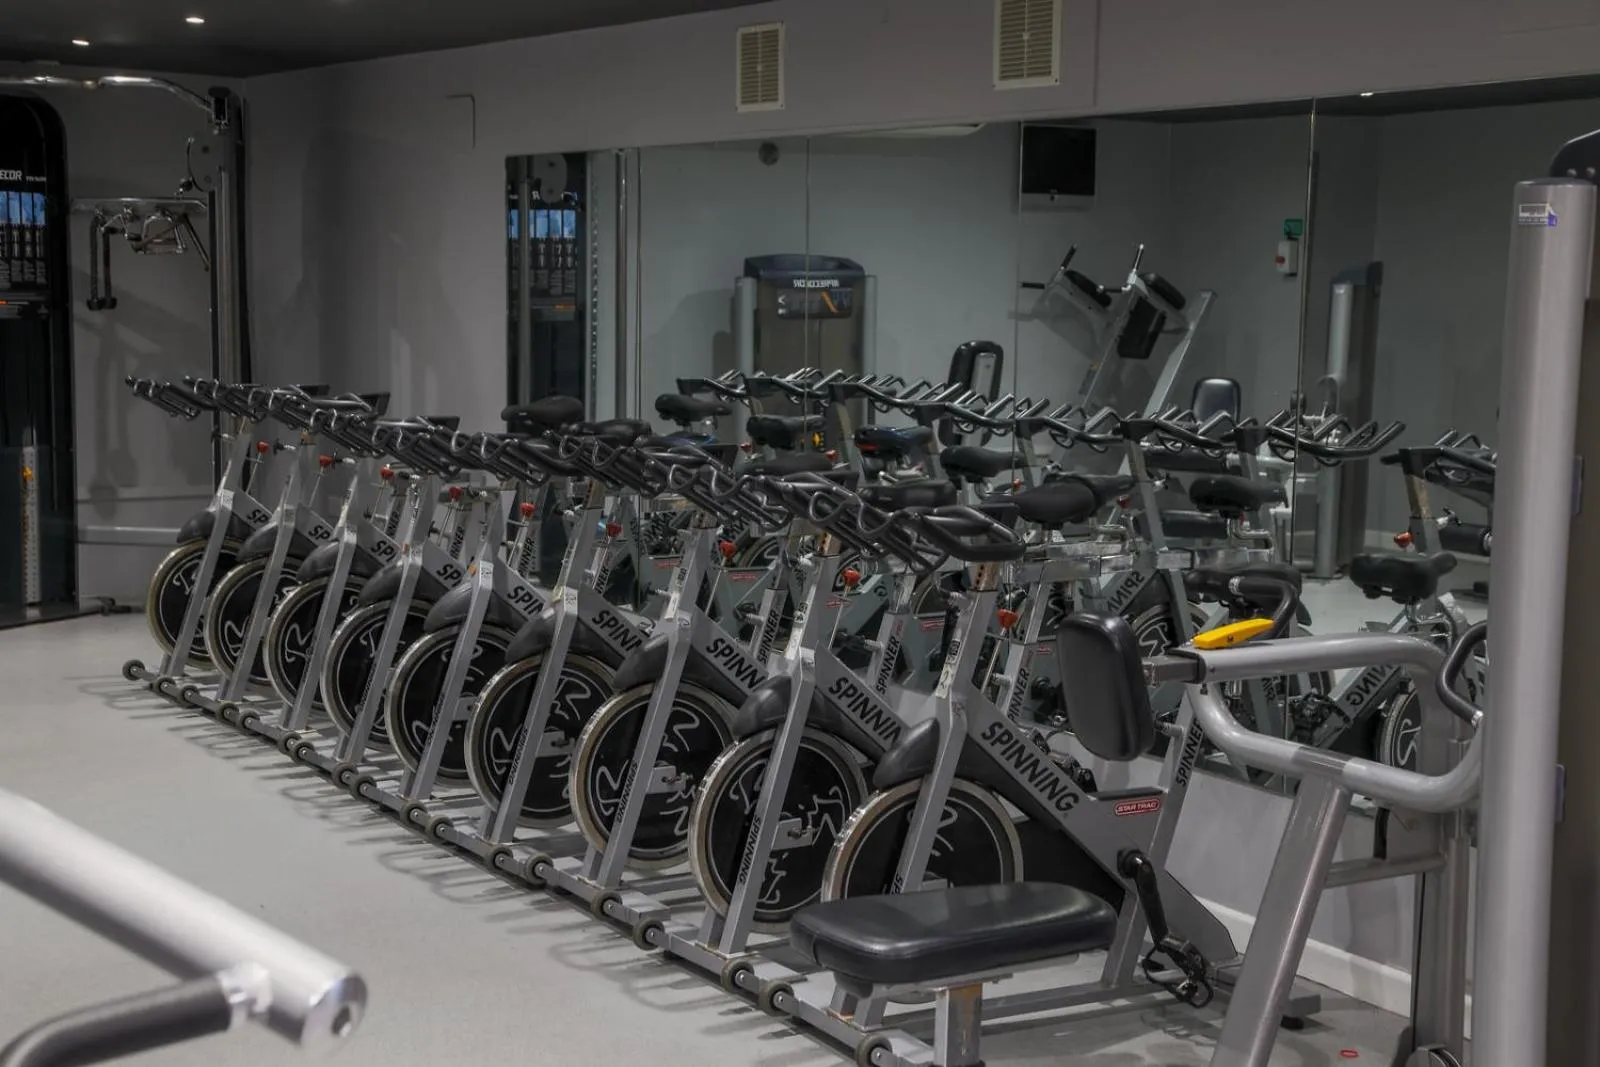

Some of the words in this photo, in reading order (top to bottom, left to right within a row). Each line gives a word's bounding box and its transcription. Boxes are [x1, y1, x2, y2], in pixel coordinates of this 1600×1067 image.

[371, 540, 397, 562] SPI
[436, 564, 462, 588] SPI
[706, 638, 765, 688] SPINN
[756, 609, 780, 665] SPINNER
[875, 636, 900, 695] SPINNER
[981, 721, 1079, 811] SPINNING
[739, 814, 761, 885] SPINNING
